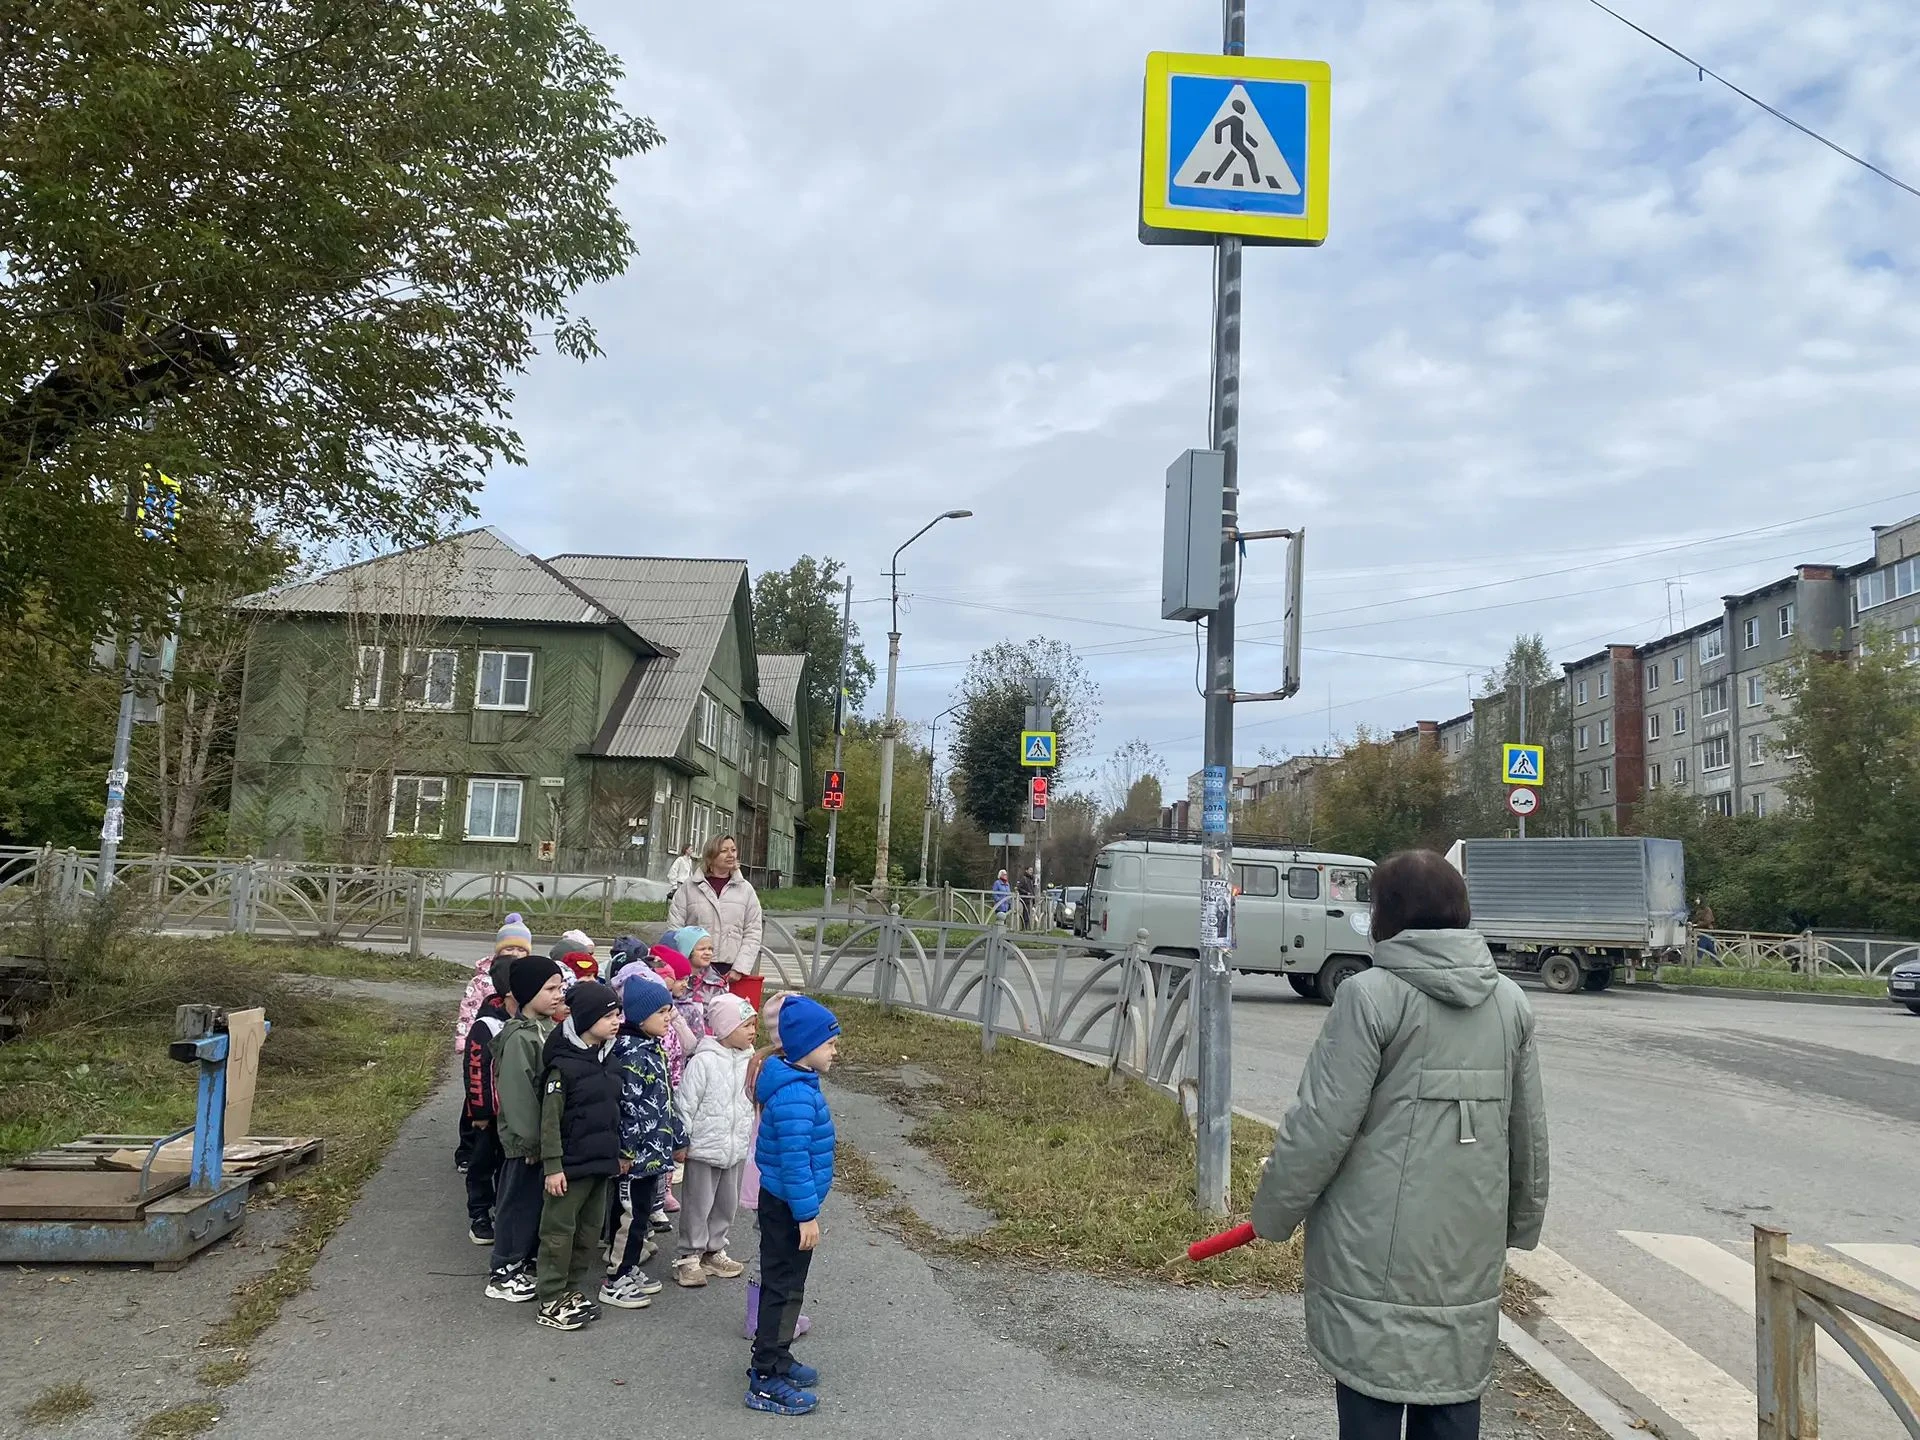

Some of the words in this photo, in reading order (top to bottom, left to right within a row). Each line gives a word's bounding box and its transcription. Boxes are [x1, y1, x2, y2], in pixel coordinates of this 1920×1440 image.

[824, 791, 843, 808] 29
[234, 1029, 259, 1079] 40
[469, 1039, 484, 1107] LUCKY
